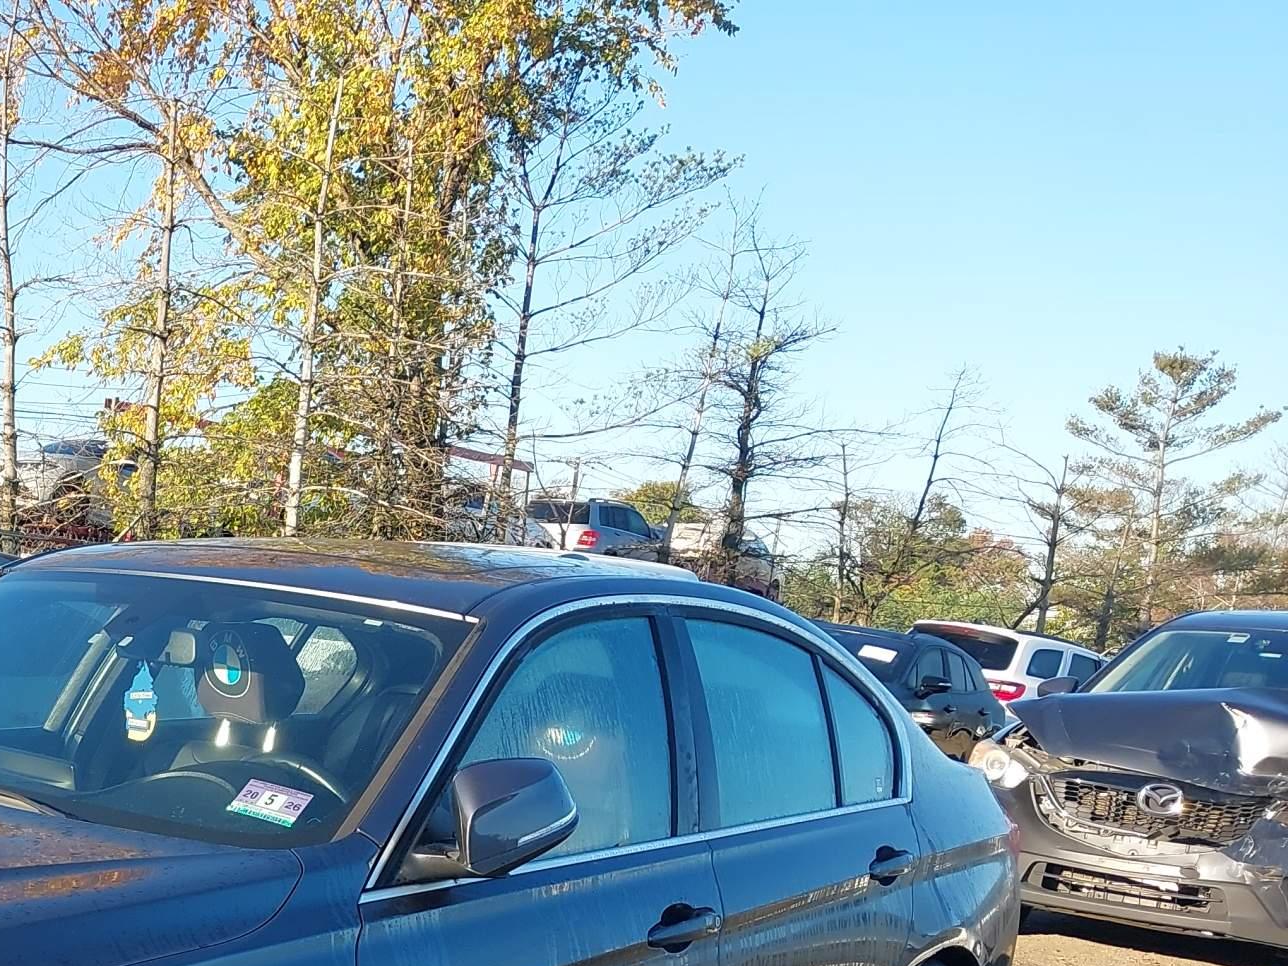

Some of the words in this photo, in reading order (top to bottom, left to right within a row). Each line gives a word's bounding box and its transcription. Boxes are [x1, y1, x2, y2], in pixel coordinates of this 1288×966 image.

[242, 789, 260, 799] 20
[264, 794, 279, 805] 5
[284, 801, 302, 811] 26
